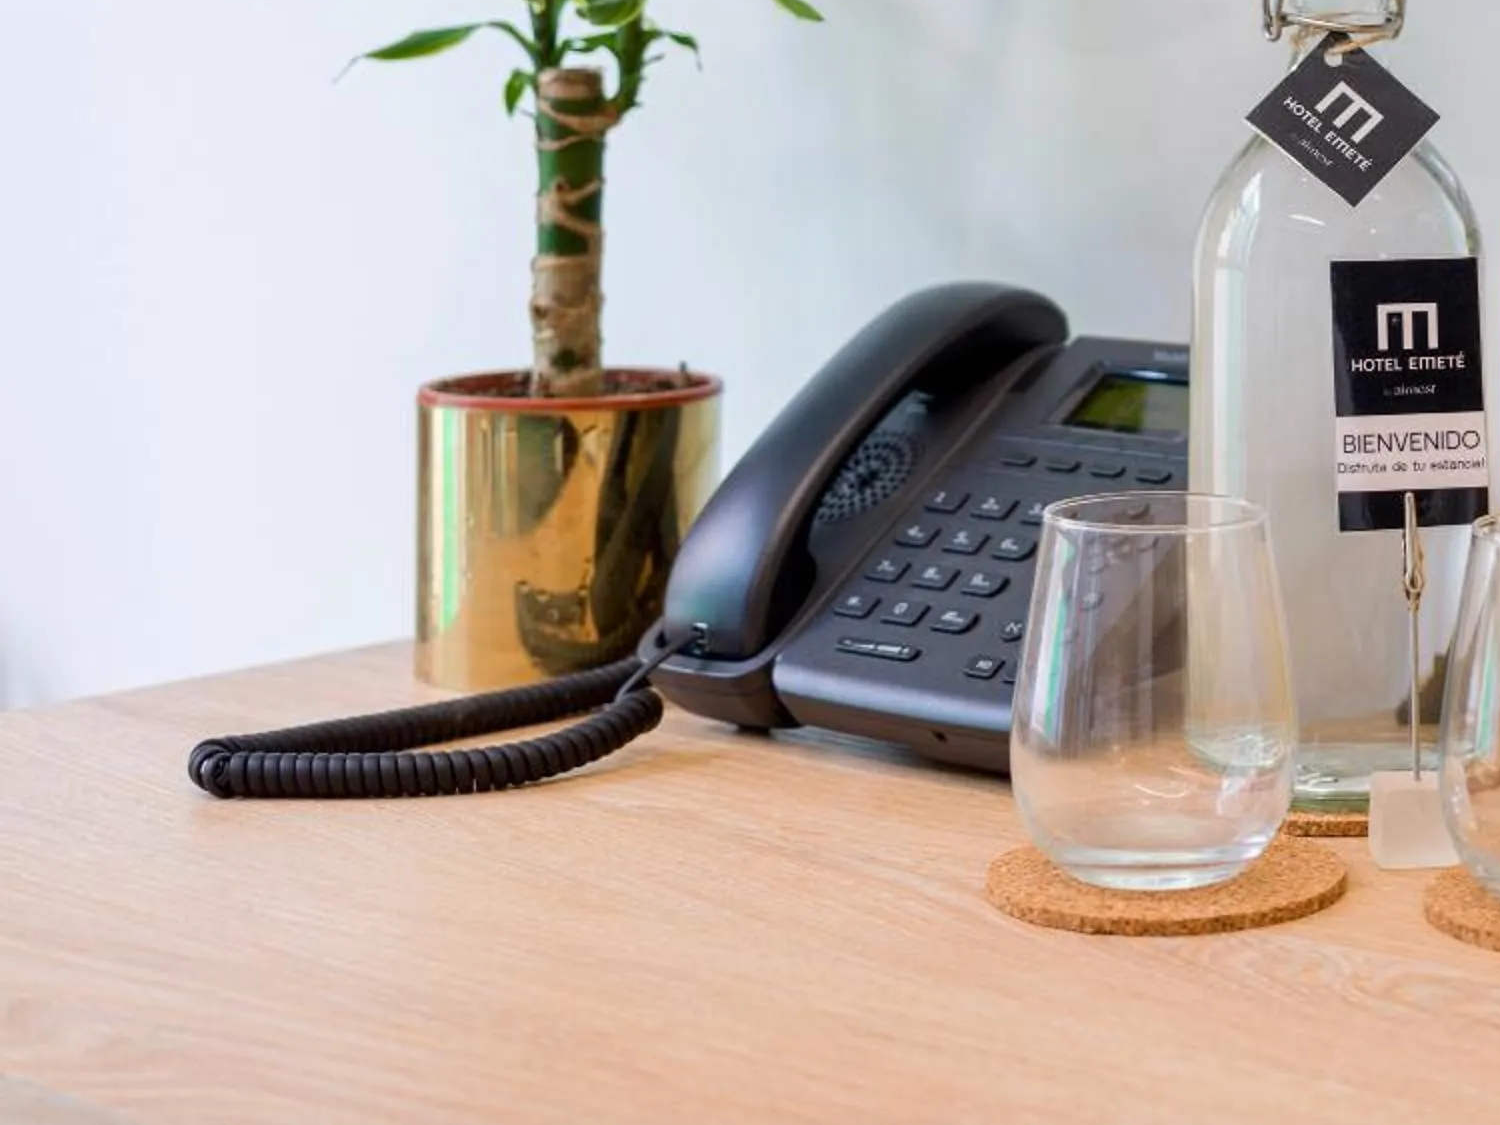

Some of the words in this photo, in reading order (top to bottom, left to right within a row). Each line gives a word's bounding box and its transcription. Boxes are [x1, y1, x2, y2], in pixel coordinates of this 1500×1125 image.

[1283, 96, 1322, 134] HOTEL
[1351, 357, 1403, 373] HOTEL
[1343, 430, 1481, 454] BIENVENIDO
[1337, 462, 1387, 474] Disfruta
[1392, 461, 1408, 472] de
[1413, 460, 1426, 472] tu
